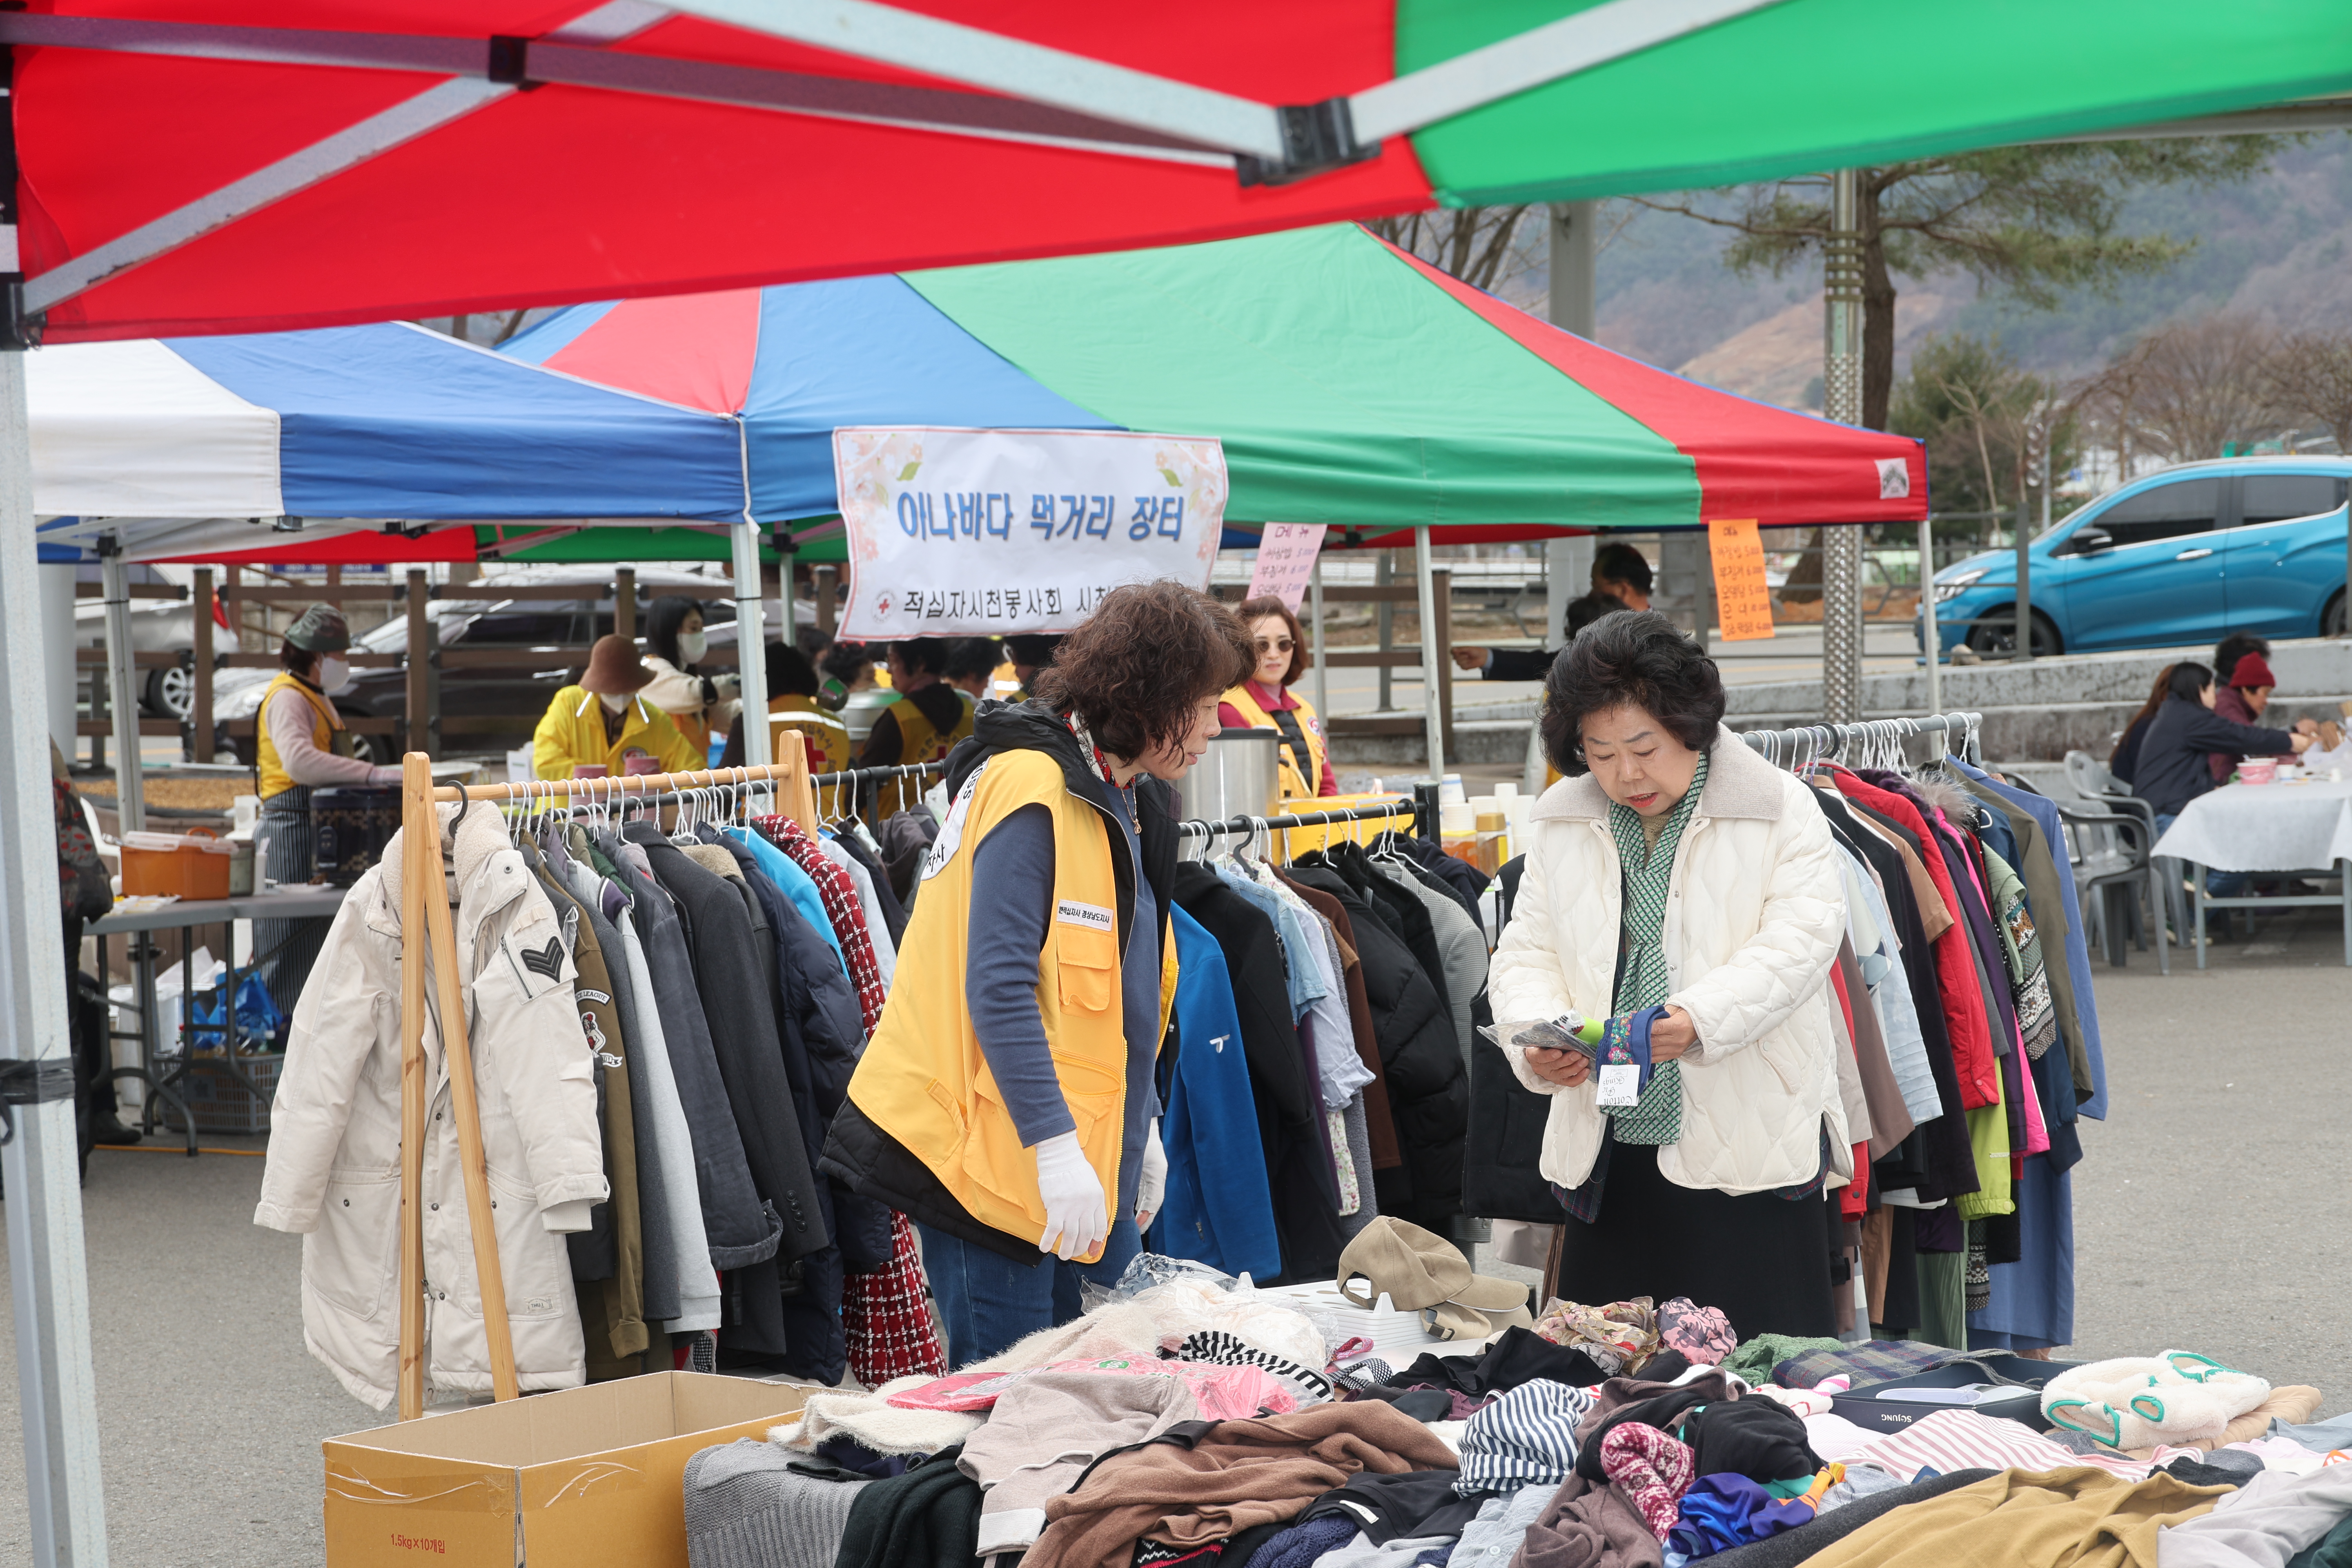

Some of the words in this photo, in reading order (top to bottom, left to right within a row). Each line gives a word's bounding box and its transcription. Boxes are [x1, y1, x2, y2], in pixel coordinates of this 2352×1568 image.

[898, 491, 1013, 541] 아나바다
[1030, 494, 1114, 540] 먹거리
[1129, 495, 1183, 541] 장터
[904, 587, 1062, 619] 적십자시천봉사회
[1082, 910, 1110, 924] 경상남도지사
[583, 991, 607, 1002] LEAGUE
[1602, 1076, 1625, 1086] Kings
[1604, 1096, 1632, 1106] Cotton
